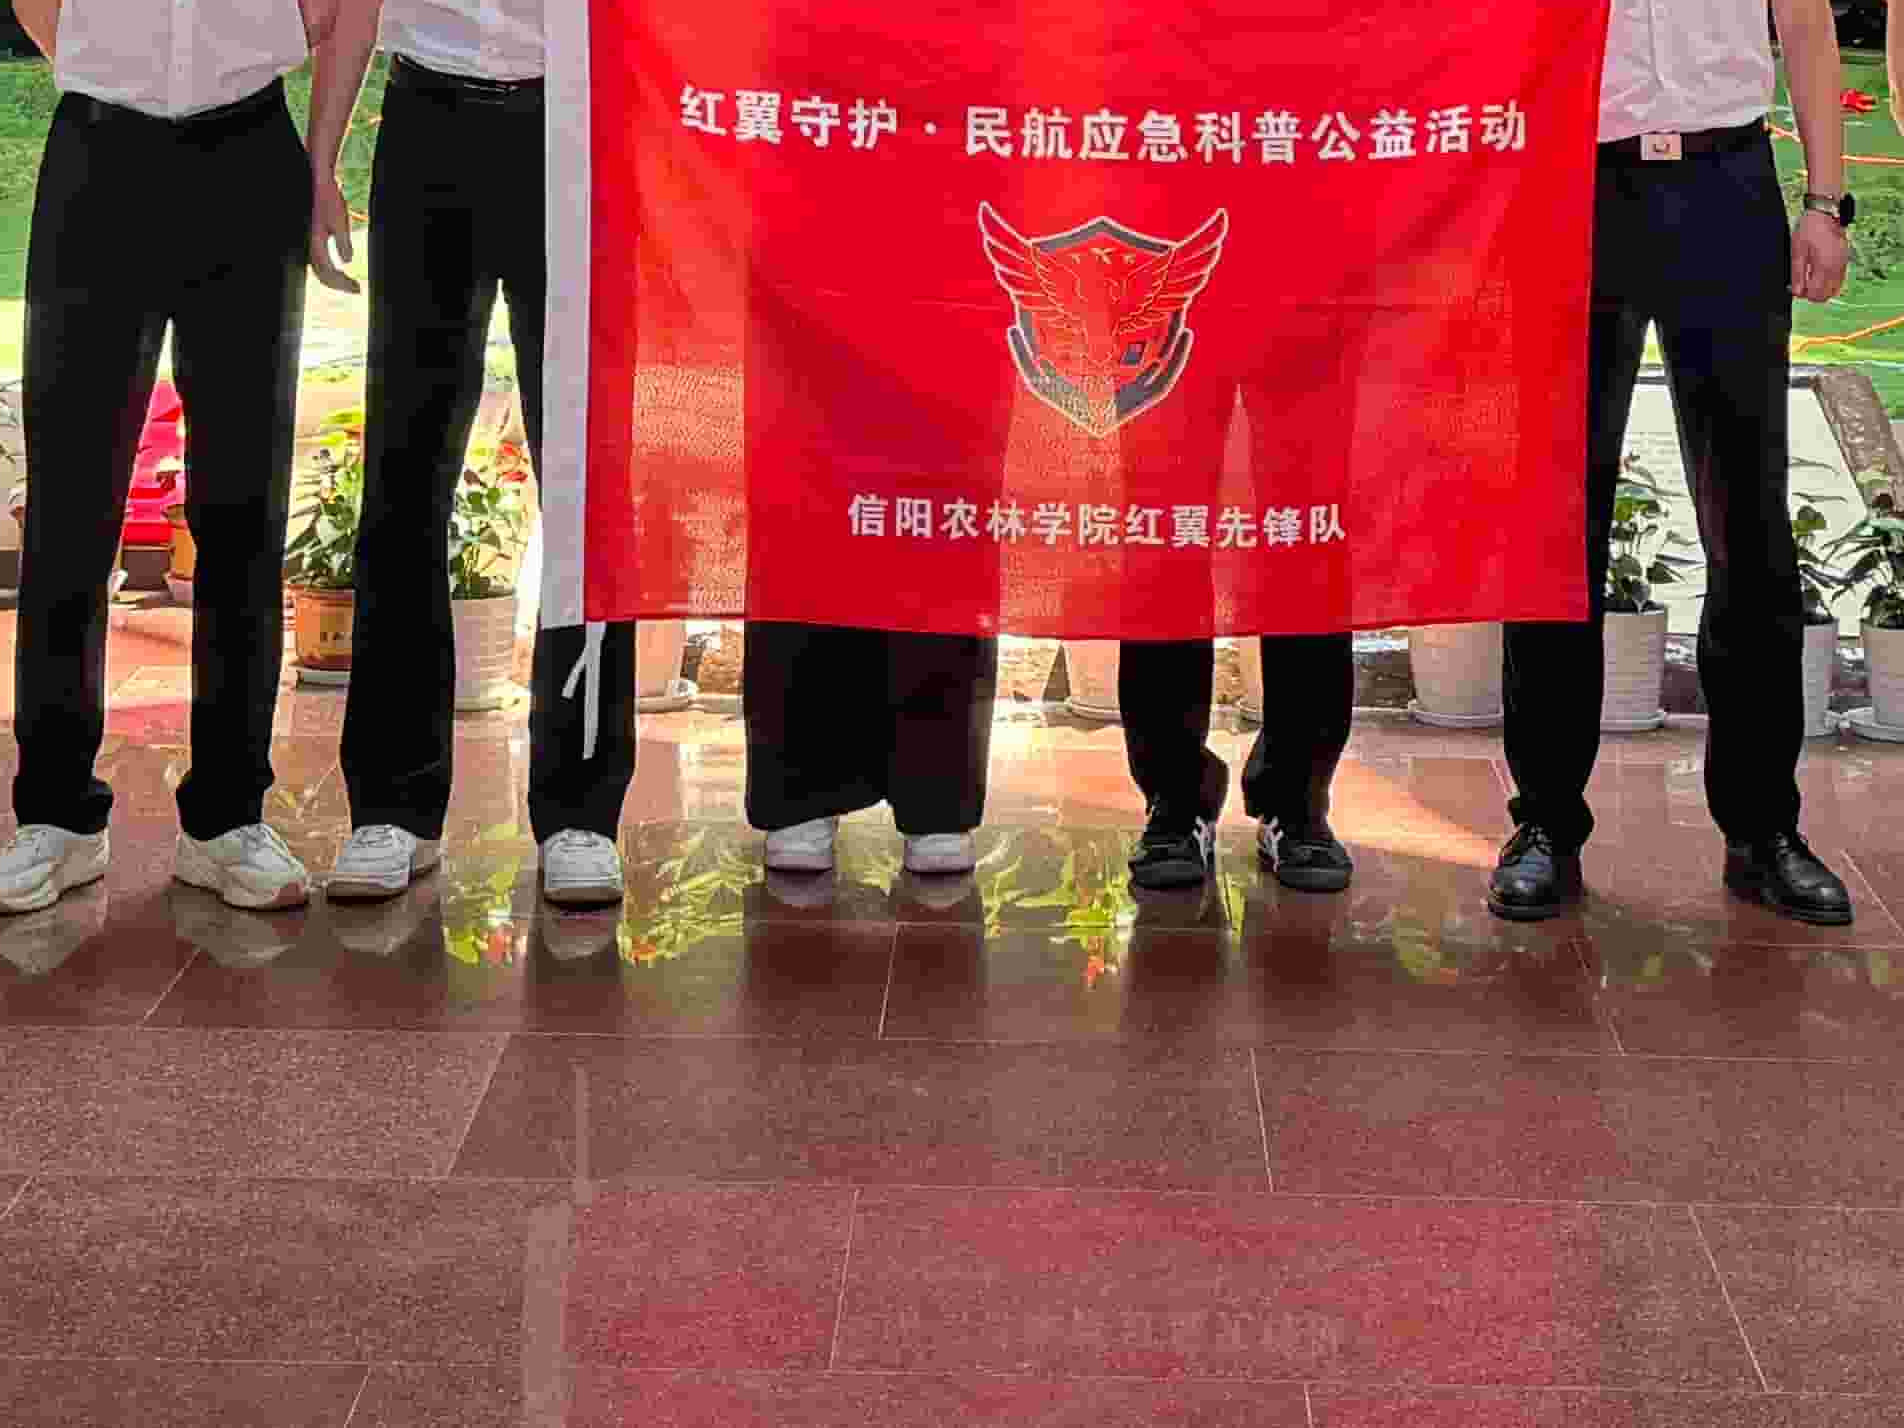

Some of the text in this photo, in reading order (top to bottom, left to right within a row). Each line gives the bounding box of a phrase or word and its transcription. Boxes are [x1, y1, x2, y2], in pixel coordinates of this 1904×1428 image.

[679, 85, 1527, 164] 红翼守护·民航应急科普公益活动
[848, 492, 1346, 548] 信阳农林学院红翼先锋队
